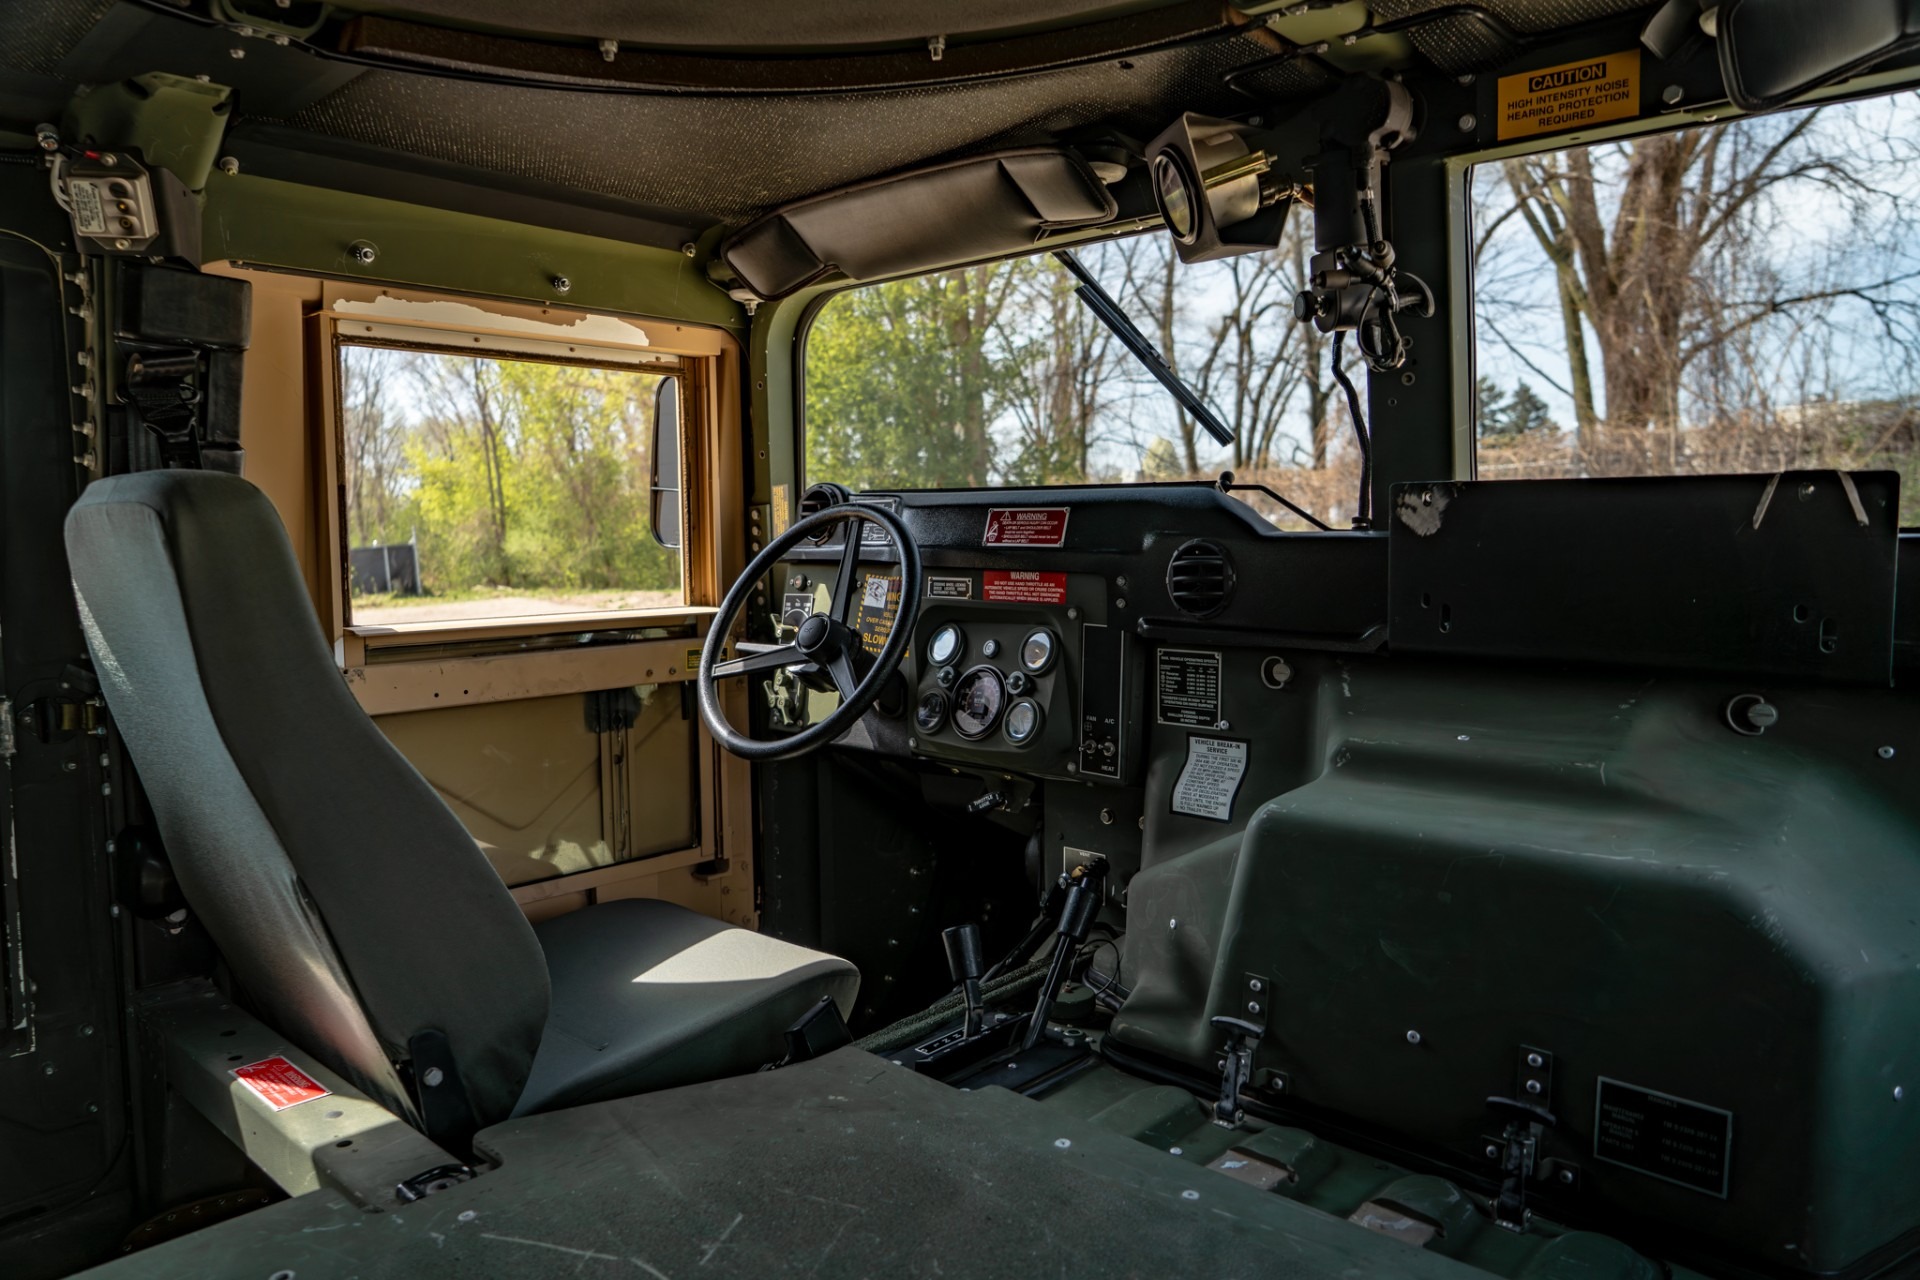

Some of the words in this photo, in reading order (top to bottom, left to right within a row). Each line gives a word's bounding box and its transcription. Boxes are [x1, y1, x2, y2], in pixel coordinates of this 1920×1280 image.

[1531, 64, 1603, 91] CAUTION
[1508, 97, 1533, 110] HIGH
[1536, 86, 1591, 104] INTENSITY
[1595, 78, 1629, 93] NOISE
[1507, 104, 1554, 121] HEARING
[1558, 90, 1630, 111] PROTECTION
[1538, 109, 1595, 127] REQUIRED
[1016, 512, 1048, 520] WARNING
[1010, 571, 1040, 581] WARNING
[1194, 739, 1215, 747] VEHICLE
[1216, 741, 1241, 750] BREAK-IN
[1206, 746, 1228, 755] SERVICE
